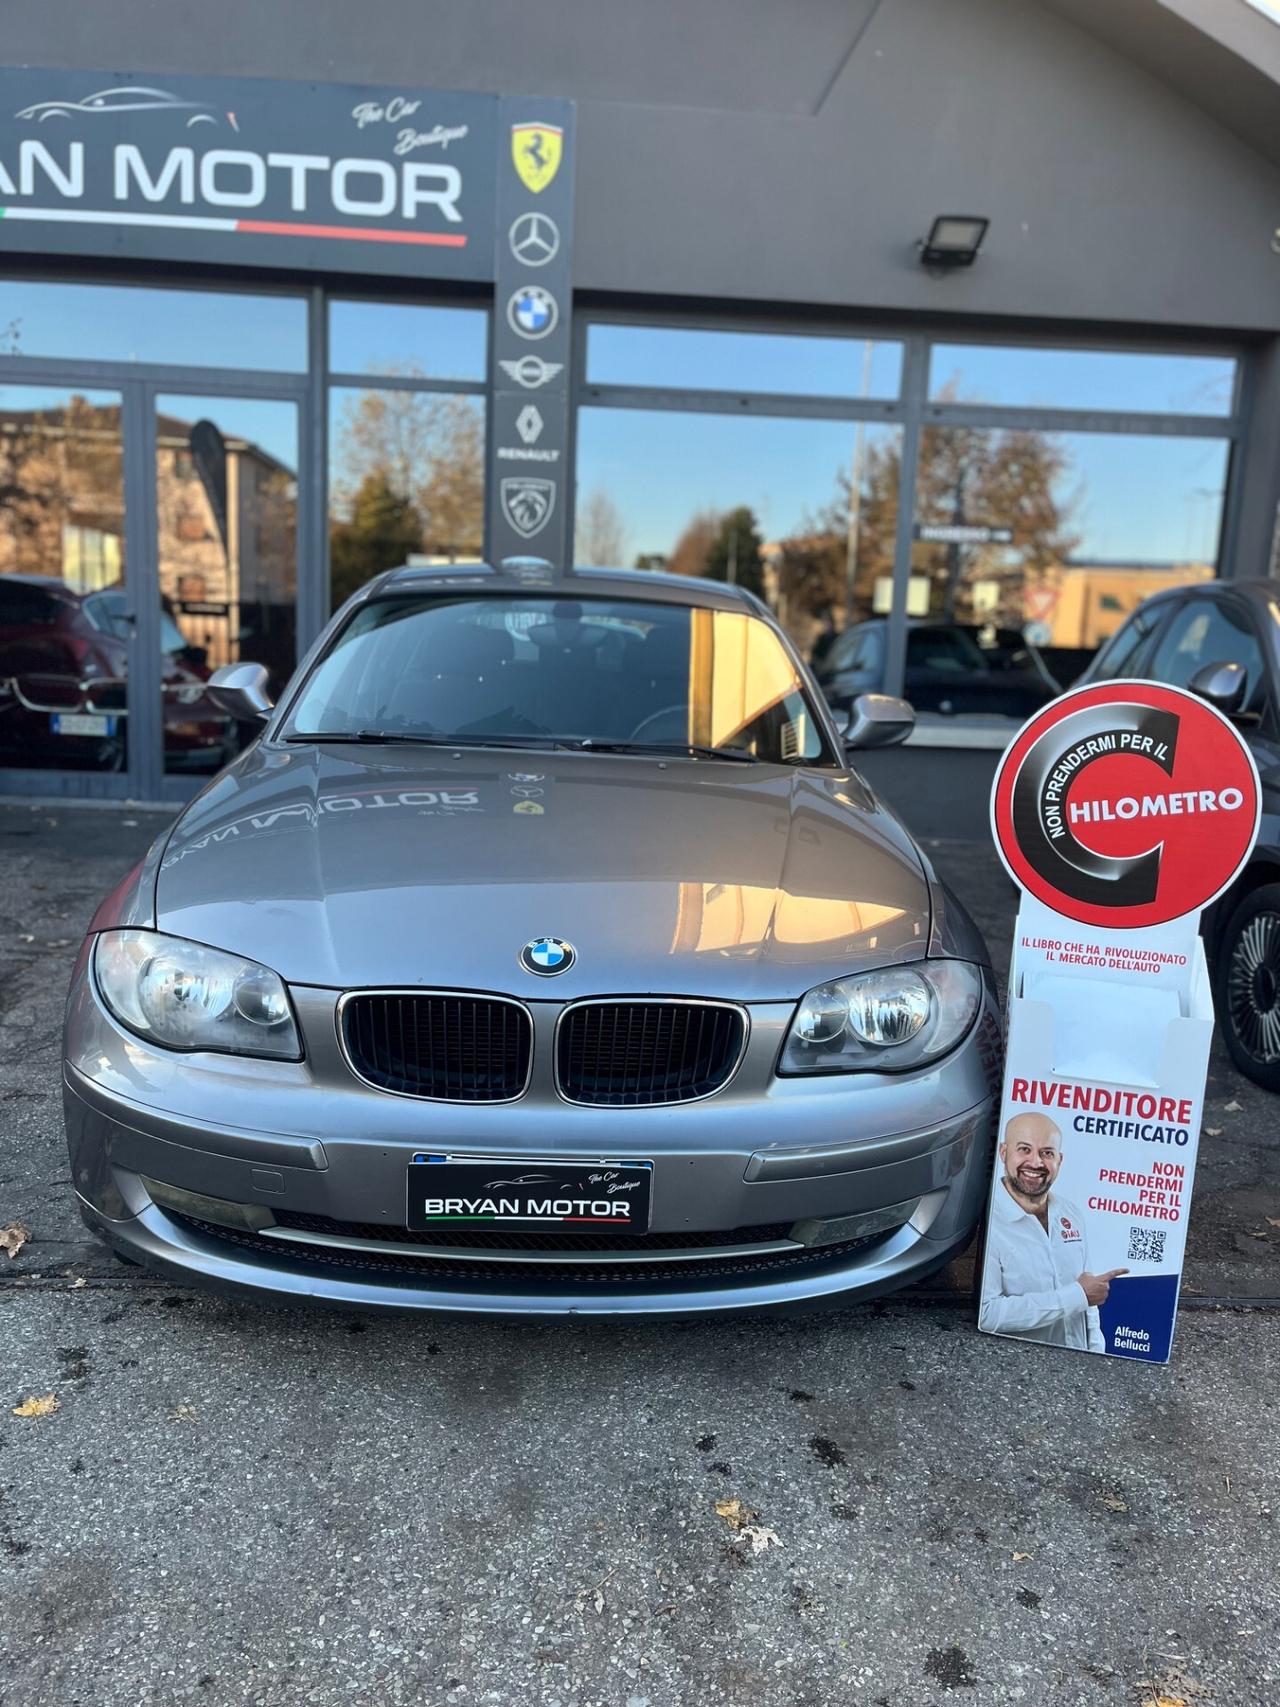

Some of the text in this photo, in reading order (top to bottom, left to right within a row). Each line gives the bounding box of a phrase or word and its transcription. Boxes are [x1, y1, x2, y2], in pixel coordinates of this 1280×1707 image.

[114, 144, 463, 223] MOTOR
[497, 447, 560, 462] RENAULT
[1045, 733, 1169, 839] NON PRENDERMI PER IL
[1069, 787, 1244, 824] HILOMETRO
[1022, 937, 1187, 966] IL LIBRO CHE HA RIVOLUZIONATO
[1046, 951, 1161, 974] IL MERCATO DELL'AUTO
[1011, 1078, 1193, 1124] RIVENDITORE
[1072, 1115, 1189, 1147] CERTIFICATO
[1099, 1169, 1184, 1192] PRENDERMI
[1152, 1161, 1185, 1178] NON
[424, 1198, 631, 1216] BRYAN MOTOR
[1088, 1196, 1181, 1221] CHILOMETRO
[1139, 1189, 1182, 1207] PER IL
[1114, 1325, 1150, 1341] Alfredo
[1113, 1337, 1151, 1353] Bellucci
